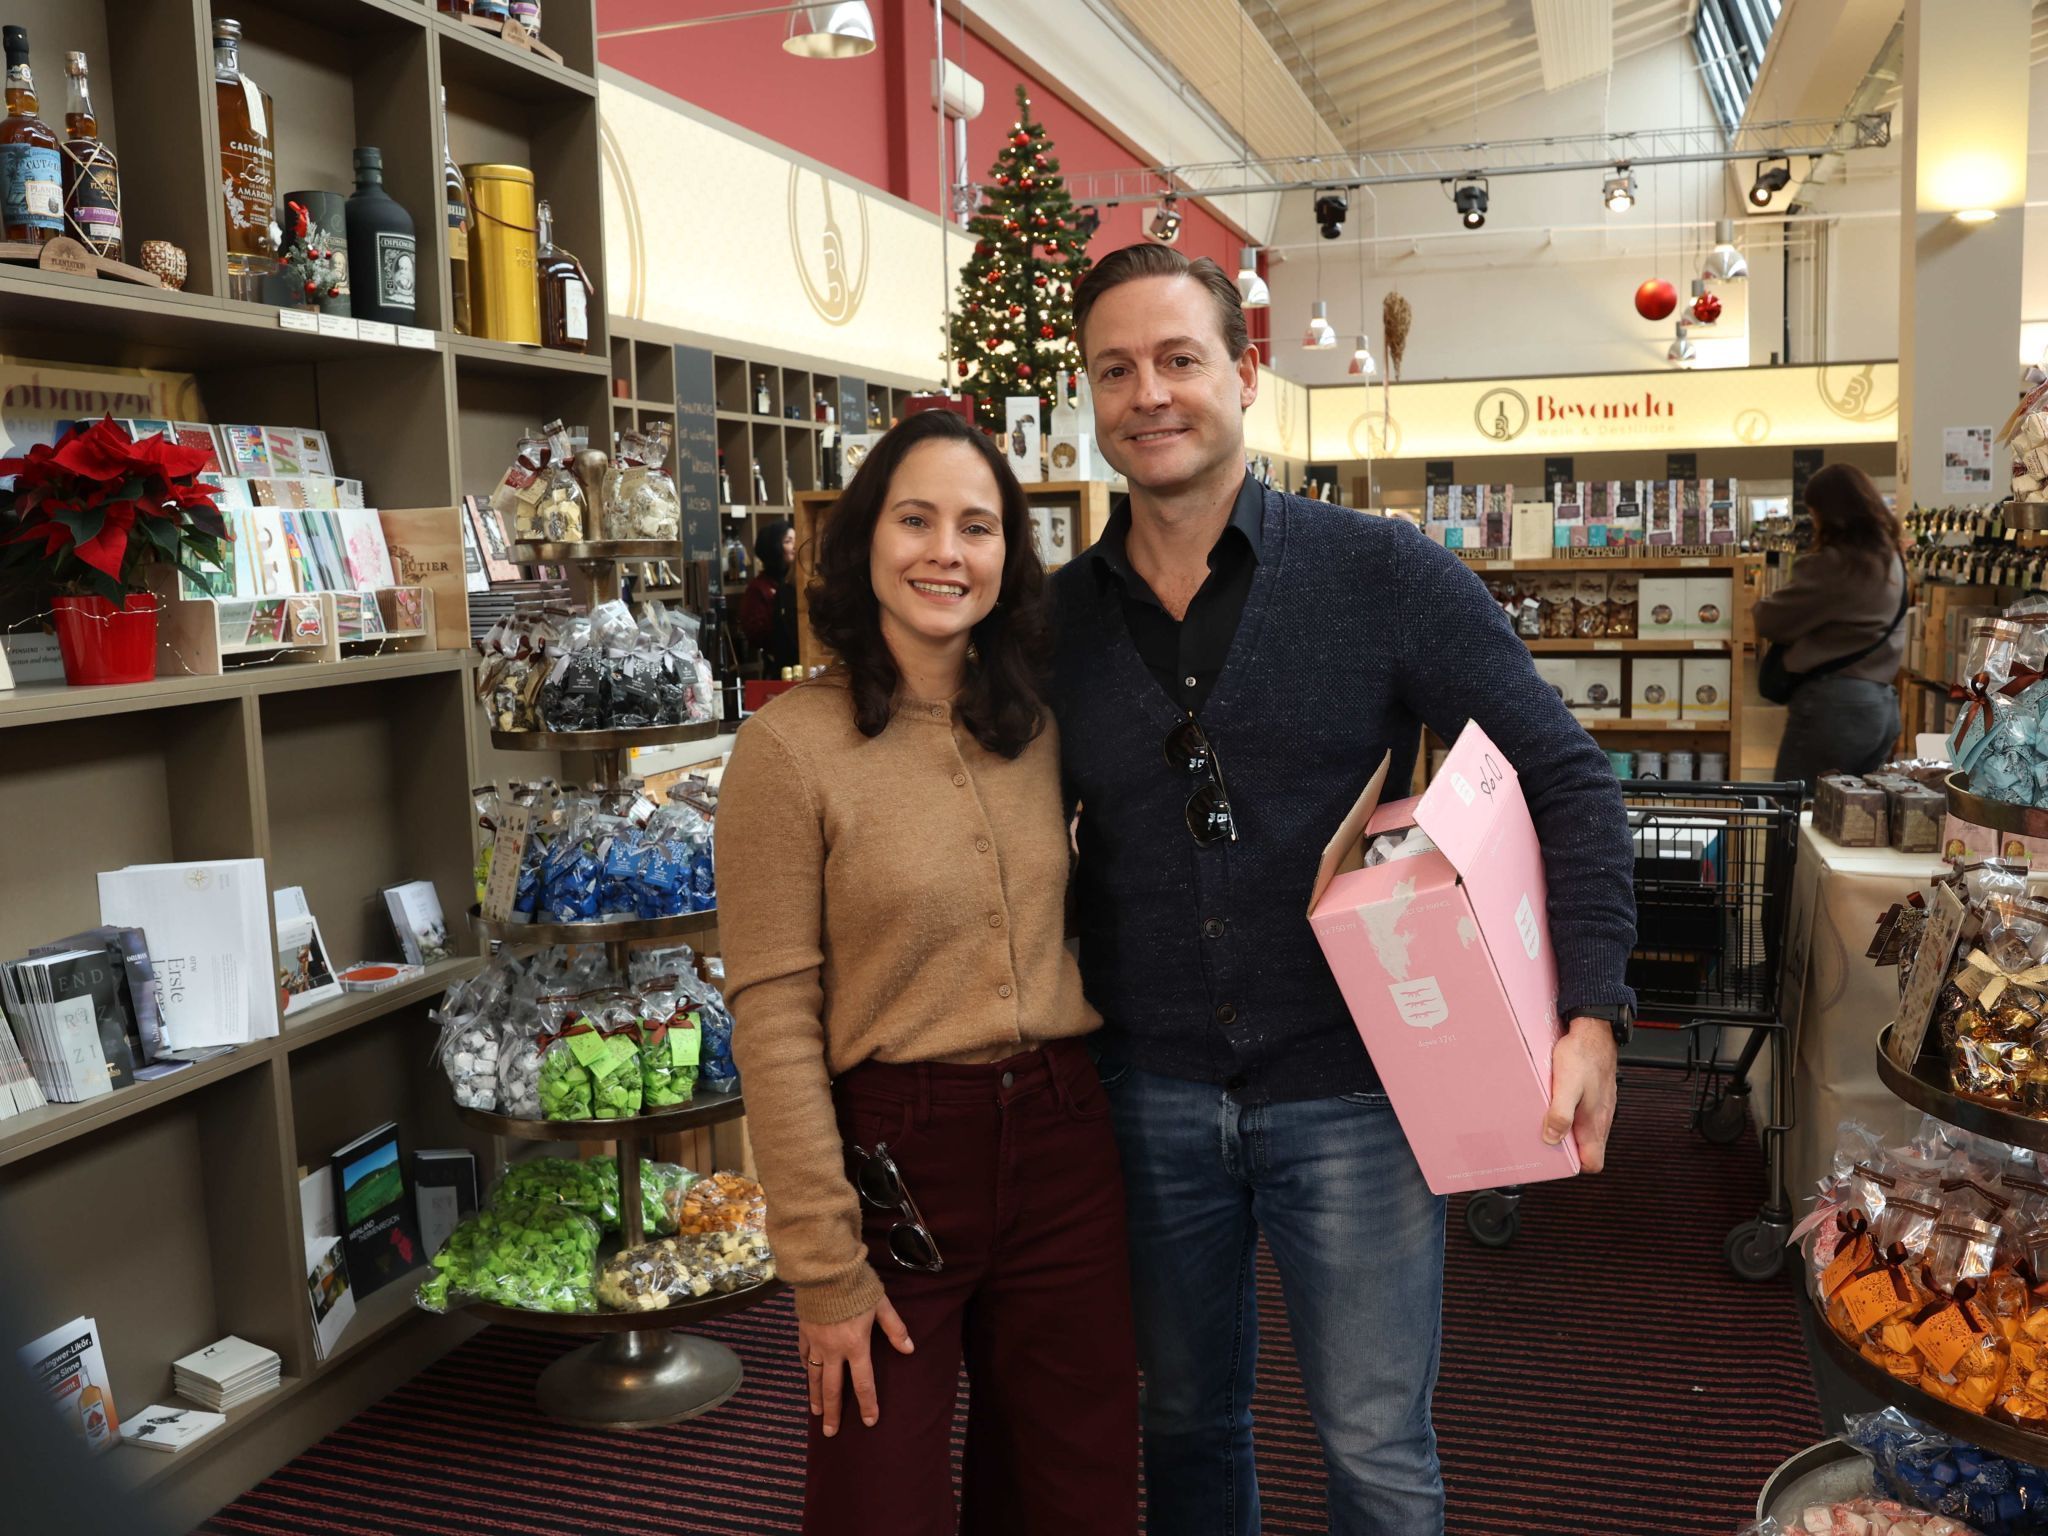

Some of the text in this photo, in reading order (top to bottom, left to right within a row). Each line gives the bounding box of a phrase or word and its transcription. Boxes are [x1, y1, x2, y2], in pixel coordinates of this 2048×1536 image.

[1537, 392, 1675, 421] Bevanda
[1599, 422, 1677, 435] Destillate
[168, 957, 186, 1004] Erste
[60, 1360, 80, 1378] Sinne
